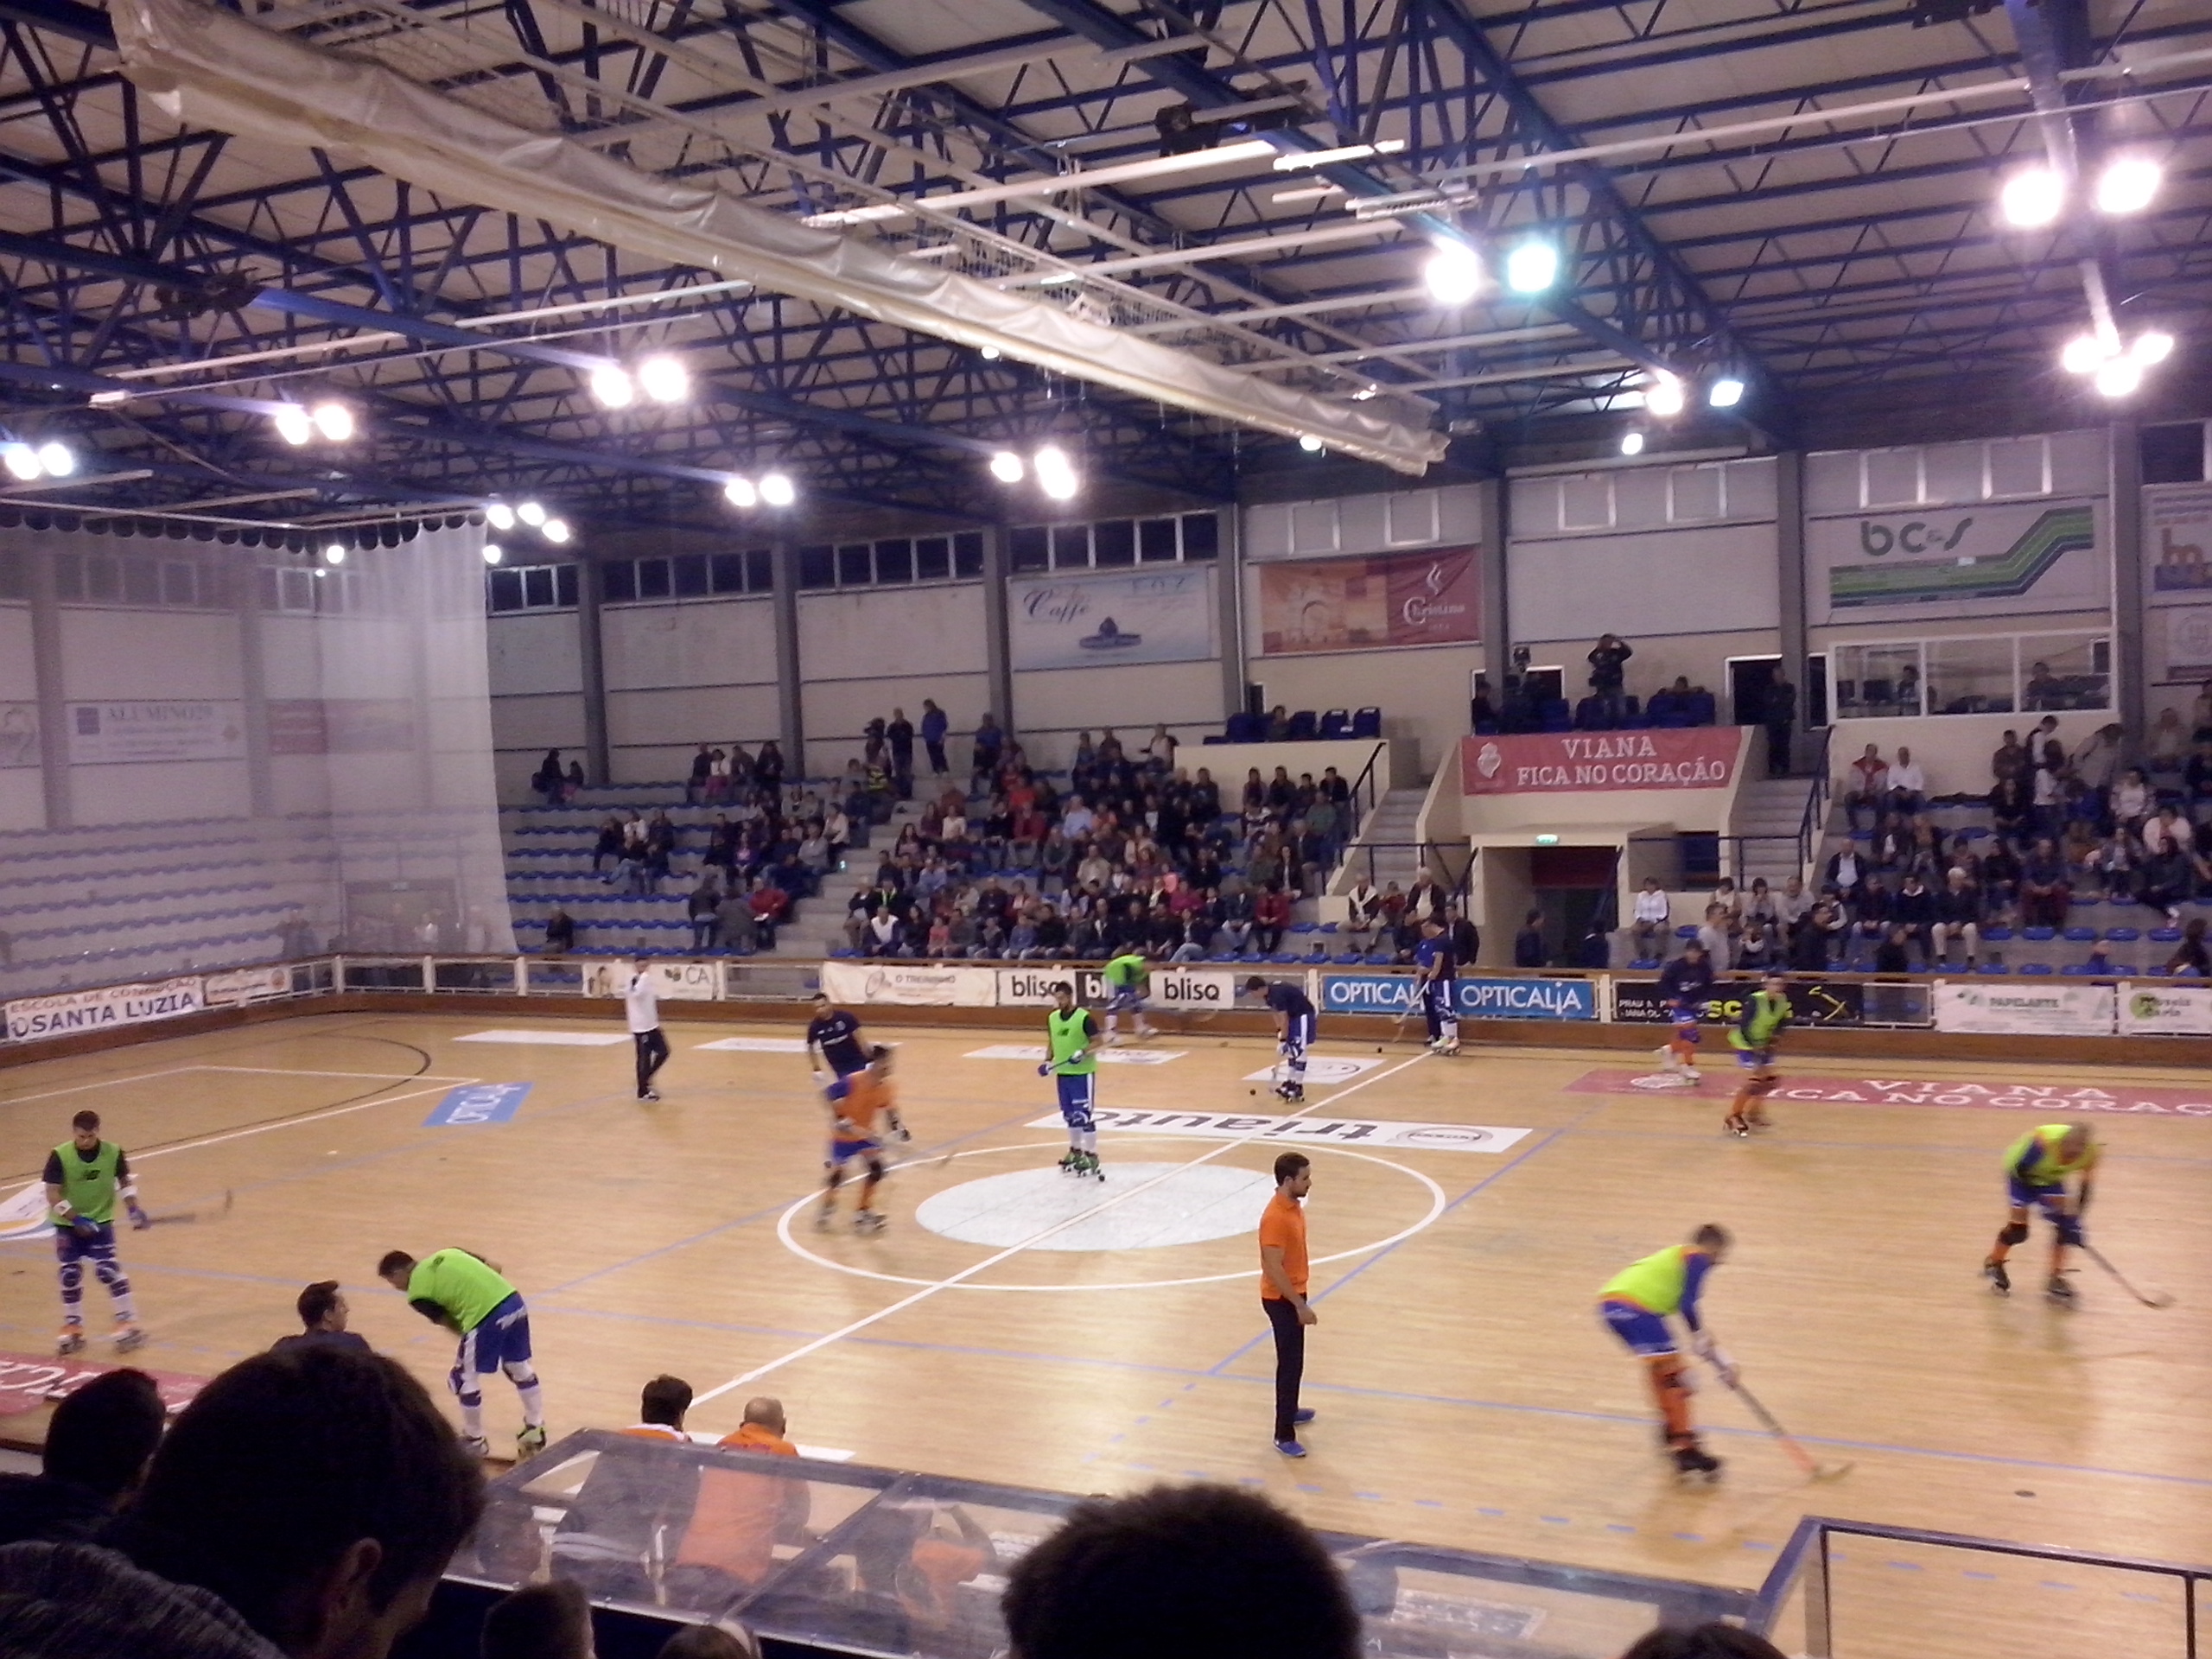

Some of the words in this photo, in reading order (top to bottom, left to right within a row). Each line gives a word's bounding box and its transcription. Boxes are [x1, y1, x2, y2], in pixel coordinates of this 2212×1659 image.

[1561, 735, 1657, 760] VIANA
[1517, 766, 1571, 785] FICA
[1575, 764, 1607, 785] NO
[1612, 757, 1726, 785] CORAÇÃO
[686, 966, 709, 985] CA
[32, 1004, 118, 1033] SANTA
[125, 992, 196, 1018] LUZIA
[1765, 1088, 1868, 1102] ICA
[1885, 1092, 1973, 1106] NO
[1862, 1080, 2116, 1099] VIANA
